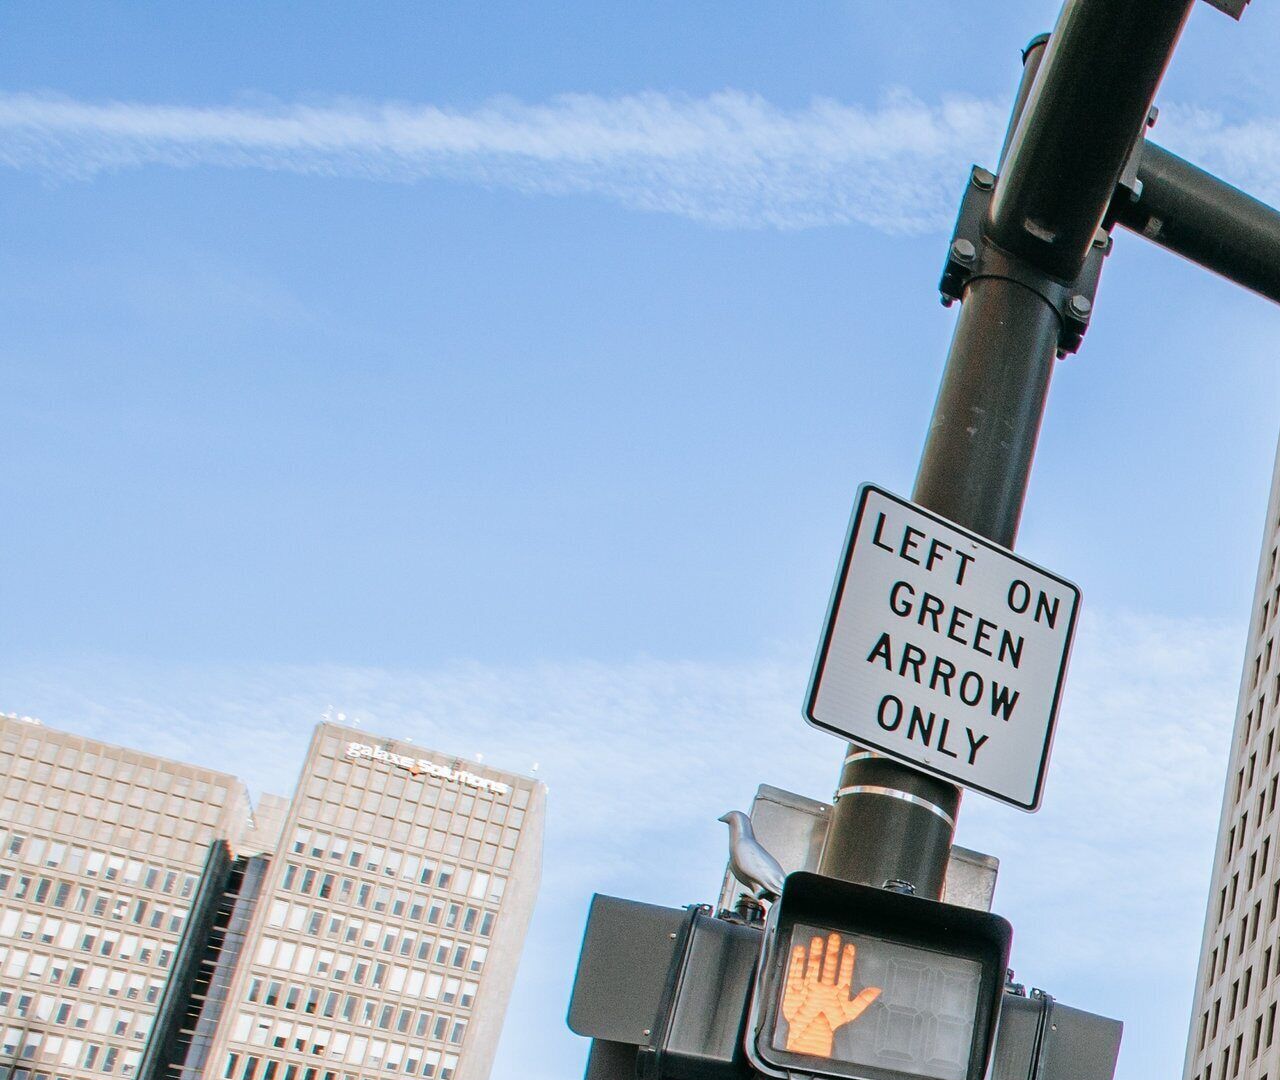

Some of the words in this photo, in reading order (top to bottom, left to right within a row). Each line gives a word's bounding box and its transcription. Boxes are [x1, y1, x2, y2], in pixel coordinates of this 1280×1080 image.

[872, 512, 975, 586] LEFT
[1007, 579, 1060, 630] ON
[889, 581, 1024, 669] GREEN
[866, 632, 1020, 722] ARROW
[877, 694, 989, 766] ONLY
